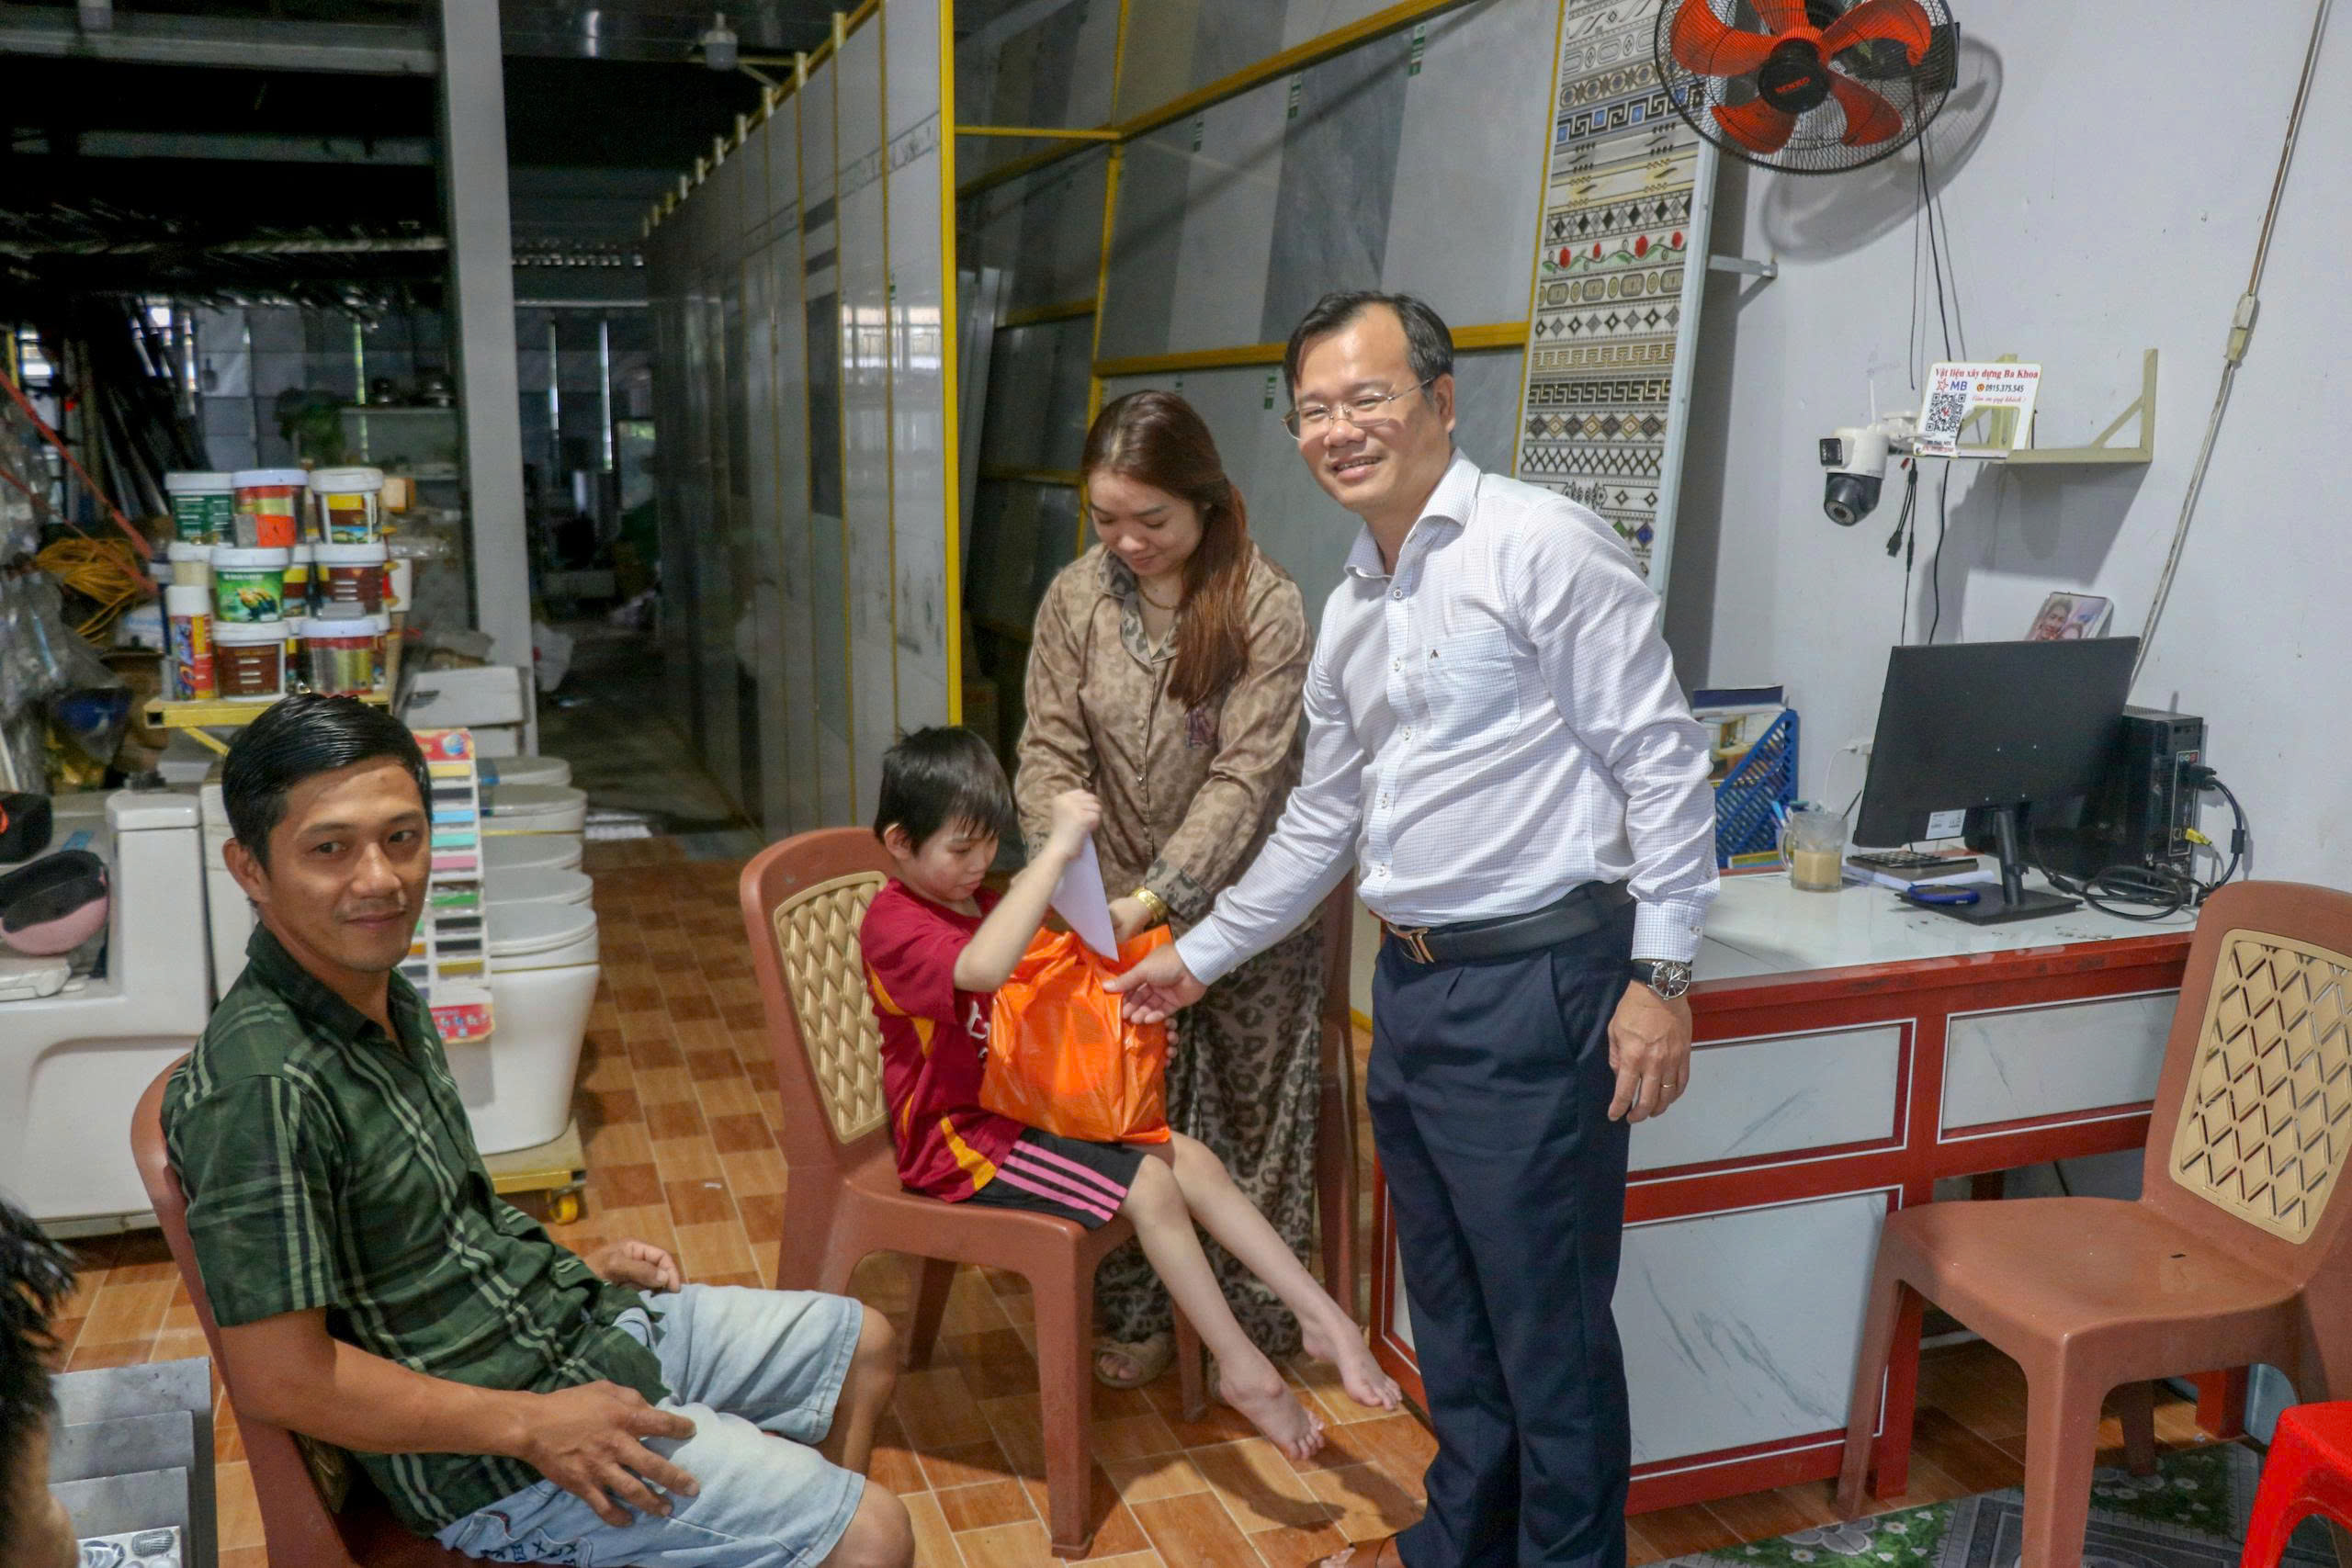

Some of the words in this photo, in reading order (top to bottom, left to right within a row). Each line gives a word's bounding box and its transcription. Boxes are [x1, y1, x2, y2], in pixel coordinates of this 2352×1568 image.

[1950, 368, 1964, 379] liệu
[1982, 369, 2002, 380] dựng
[2004, 369, 2015, 378] Ba
[2017, 369, 2039, 379] Khoa
[1950, 380, 1968, 391] MB
